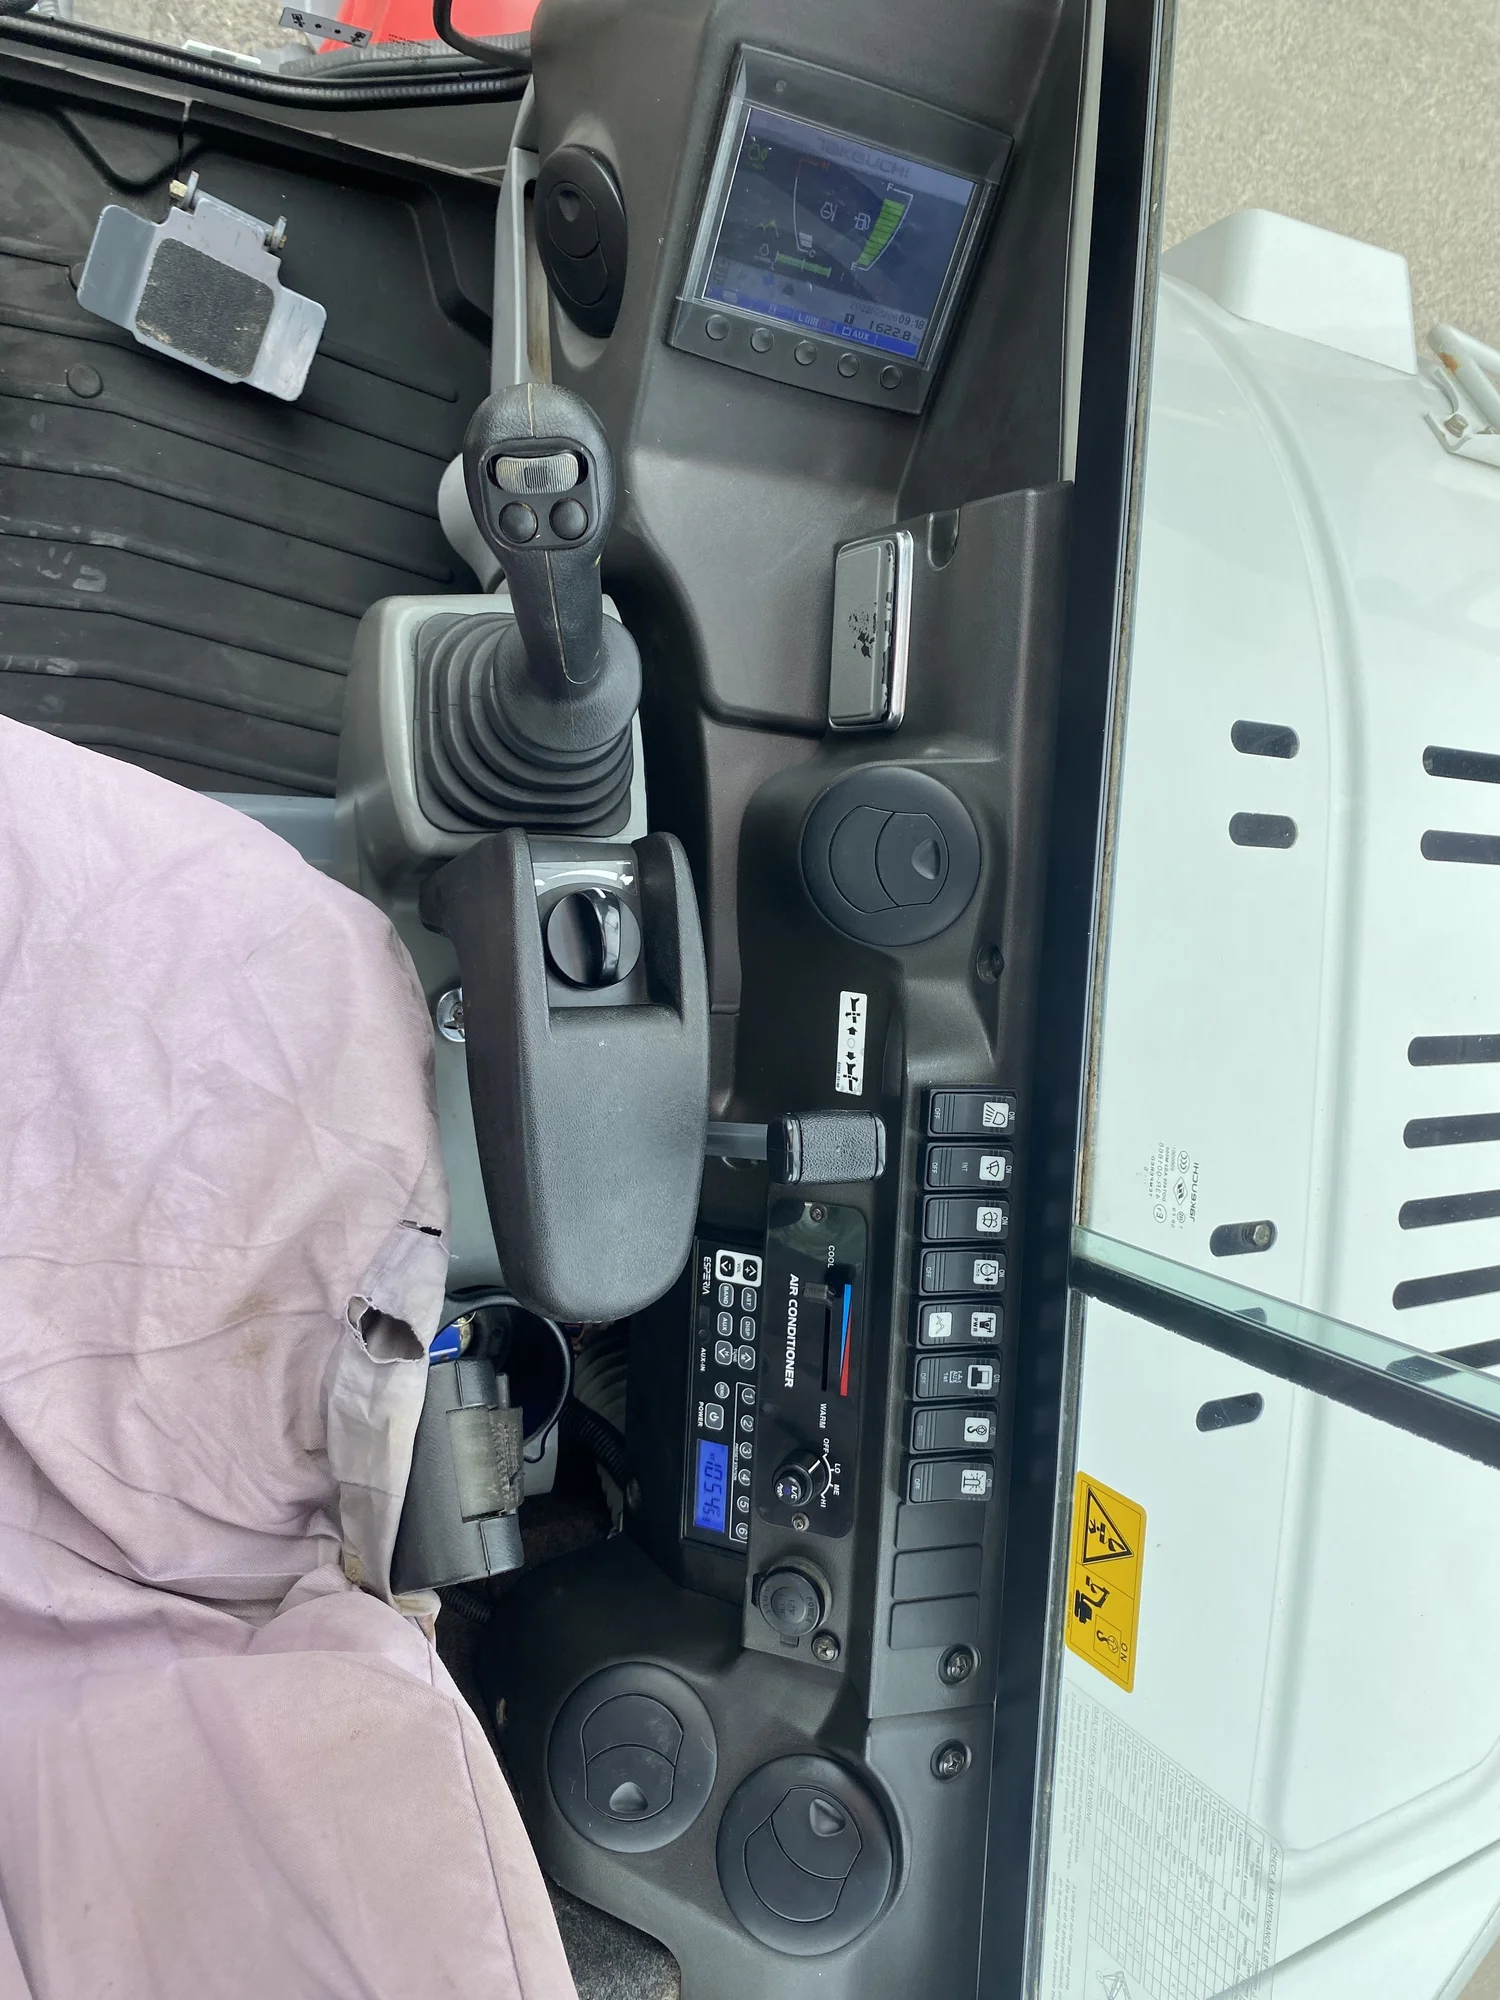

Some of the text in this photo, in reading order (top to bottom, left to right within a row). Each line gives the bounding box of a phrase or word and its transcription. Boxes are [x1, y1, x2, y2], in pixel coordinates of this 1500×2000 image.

[886, 183, 894, 191] F
[851, 262, 857, 271] E
[899, 315, 925, 330] 09:18
[852, 331, 870, 341] AUX
[1008, 1111, 1016, 1121] ON
[931, 1162, 939, 1174] OFF
[1005, 1165, 1013, 1174] ON
[1001, 1216, 1009, 1226] ON
[827, 1245, 836, 1269] COOL
[702, 1256, 712, 1295] ESPERIA
[998, 1268, 1006, 1278] ON
[784, 1273, 799, 1388] AIR CONDITIONER
[993, 1373, 1000, 1383] ON
[697, 1401, 705, 1427] POWER
[819, 1403, 828, 1429] WARM
[743, 1419, 752, 1427] 2
[989, 1426, 997, 1436] ON
[834, 1463, 842, 1474] LO
[986, 1478, 993, 1488] ON
[833, 1484, 841, 1496] ME
[740, 1500, 749, 1508] 5
[820, 1498, 827, 1508] HI
[739, 1527, 748, 1535] 6
[806, 1596, 815, 1623] POWER
[1119, 1642, 1129, 1663] ON
[1086, 1706, 1100, 1823] DAILY CHECK FOR ENGINE
[1270, 1847, 1279, 1878] CHECK
[1264, 1887, 1276, 1949] MAINTENANCE
[1263, 1949, 1271, 1970] LIST
